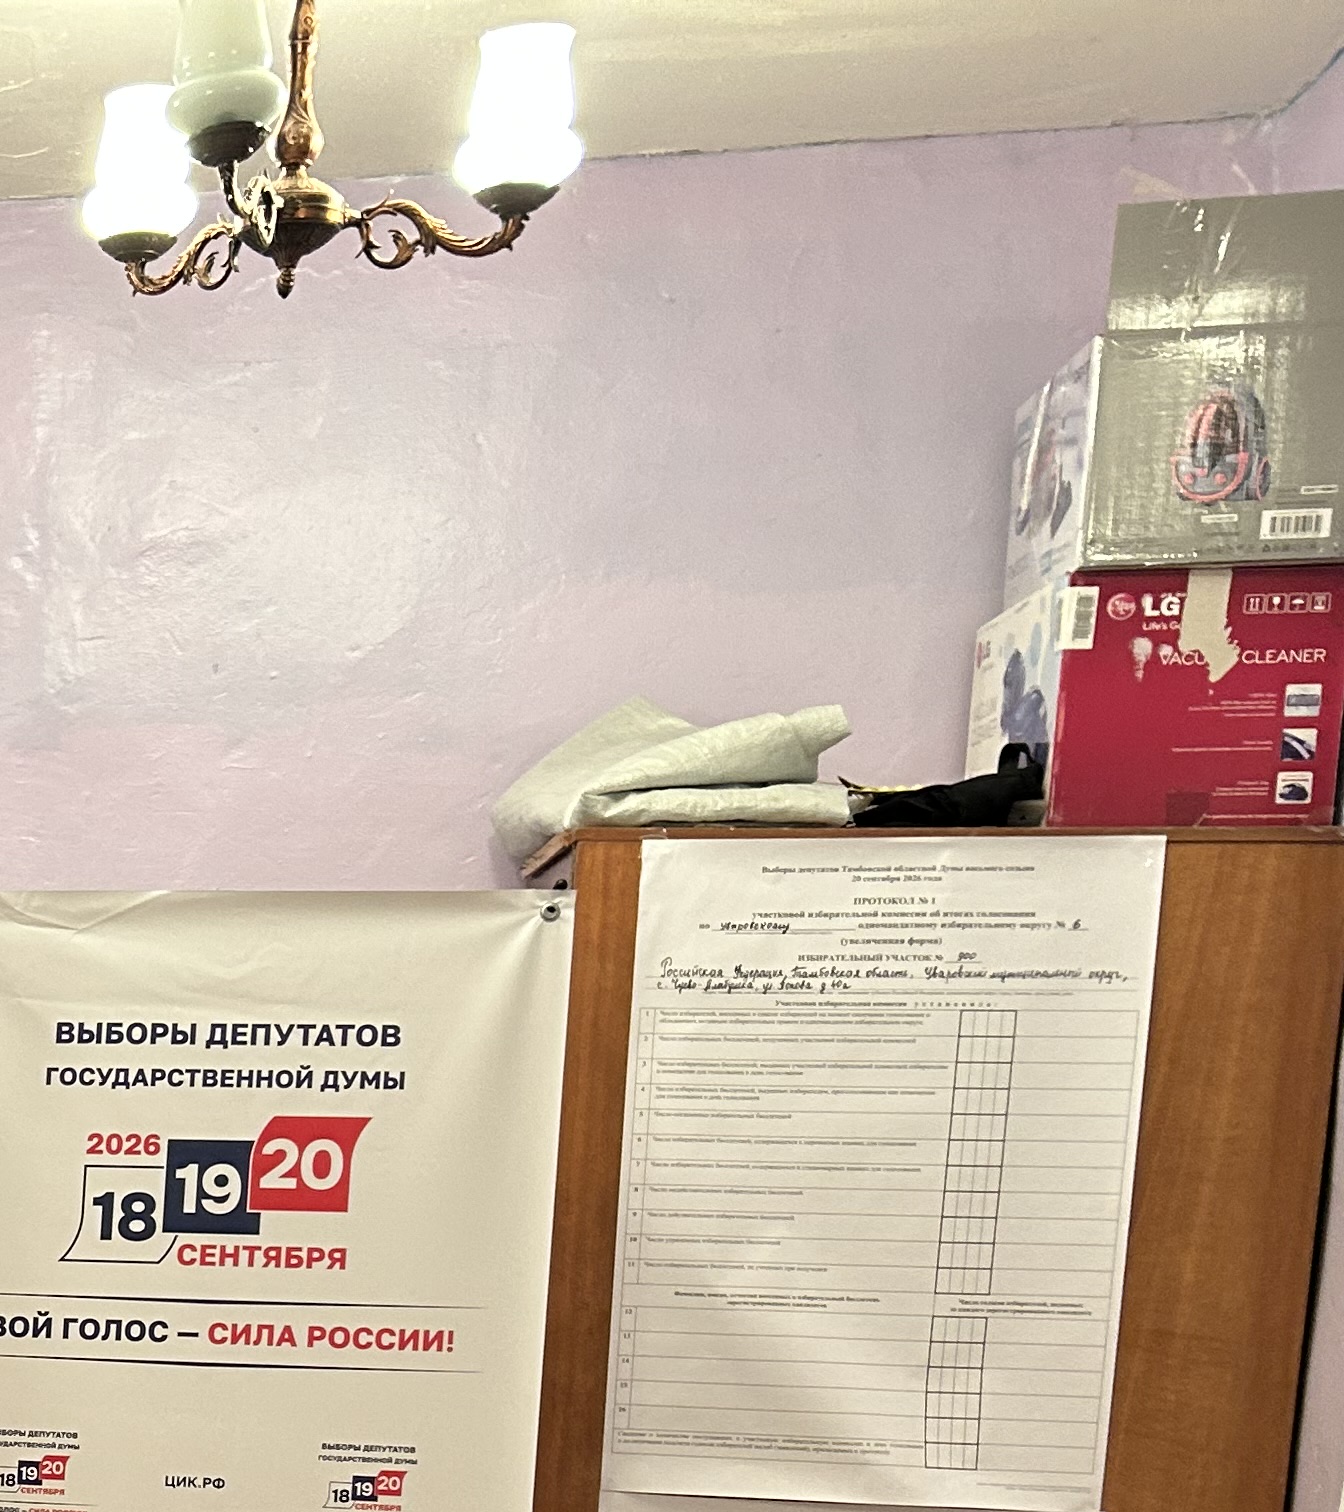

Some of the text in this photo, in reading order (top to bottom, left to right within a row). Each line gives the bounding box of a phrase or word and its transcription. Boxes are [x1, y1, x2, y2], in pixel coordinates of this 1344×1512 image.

[1142, 595, 1180, 617] LG
[1241, 648, 1327, 664] CLEANER
[853, 897, 915, 906] ПРОТОКОЛ
[56, 1022, 400, 1049] ВЫБОРЫ ДЕПУТАТОВ
[46, 1065, 405, 1092] ГОСУДАРСТВЕННОЙ ДУМЫ
[86, 1133, 160, 1155] 2026
[93, 1137, 345, 1241] 18 19 20
[177, 1244, 346, 1270] СЕНТЯБРЯ
[63, 1318, 168, 1342] ГОЛОС
[208, 1323, 297, 1347] СИЛА
[307, 1326, 453, 1352] РОССИИ!
[27, 1430, 78, 1439] ДЕПУТАТОВ
[19, 1466, 38, 1481] 19
[41, 1461, 64, 1475] 20
[20, 1487, 65, 1495] СЕНТЯБРЯ
[164, 1475, 226, 1490] ЦИК.РФ
[331, 1476, 401, 1503] 18 19 20
